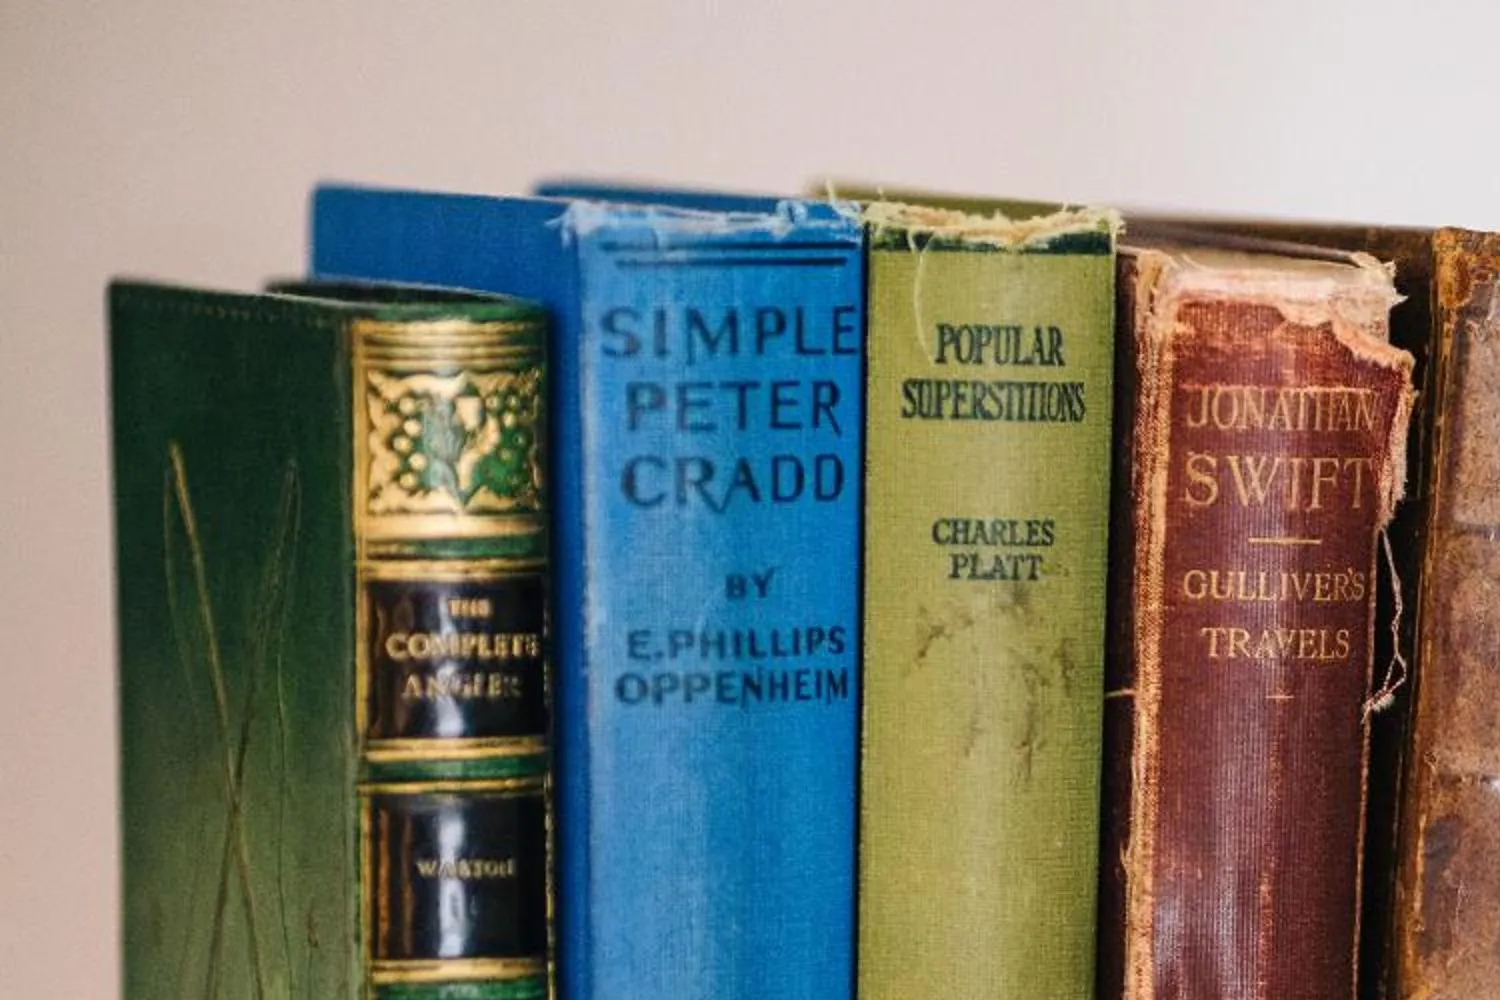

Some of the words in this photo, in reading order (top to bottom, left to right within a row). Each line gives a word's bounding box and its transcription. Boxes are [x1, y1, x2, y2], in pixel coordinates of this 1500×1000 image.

[602, 305, 857, 366] SIMPLE
[934, 323, 1066, 366] POPULAR
[625, 380, 842, 436] PETER
[902, 378, 1086, 422] SUPERSTITIONS
[1185, 385, 1378, 432] JONATHAN
[620, 453, 845, 515] CRADD
[1184, 453, 1373, 512] SWIFT
[932, 517, 1055, 547] CHARLES
[725, 566, 775, 600] BY
[948, 552, 1044, 581] PLATT
[1183, 567, 1365, 602] GULLIVER'S
[385, 632, 540, 661] COMPLETE
[1200, 627, 1350, 659] TRAVELS
[614, 667, 849, 707] OPPENHEIM
